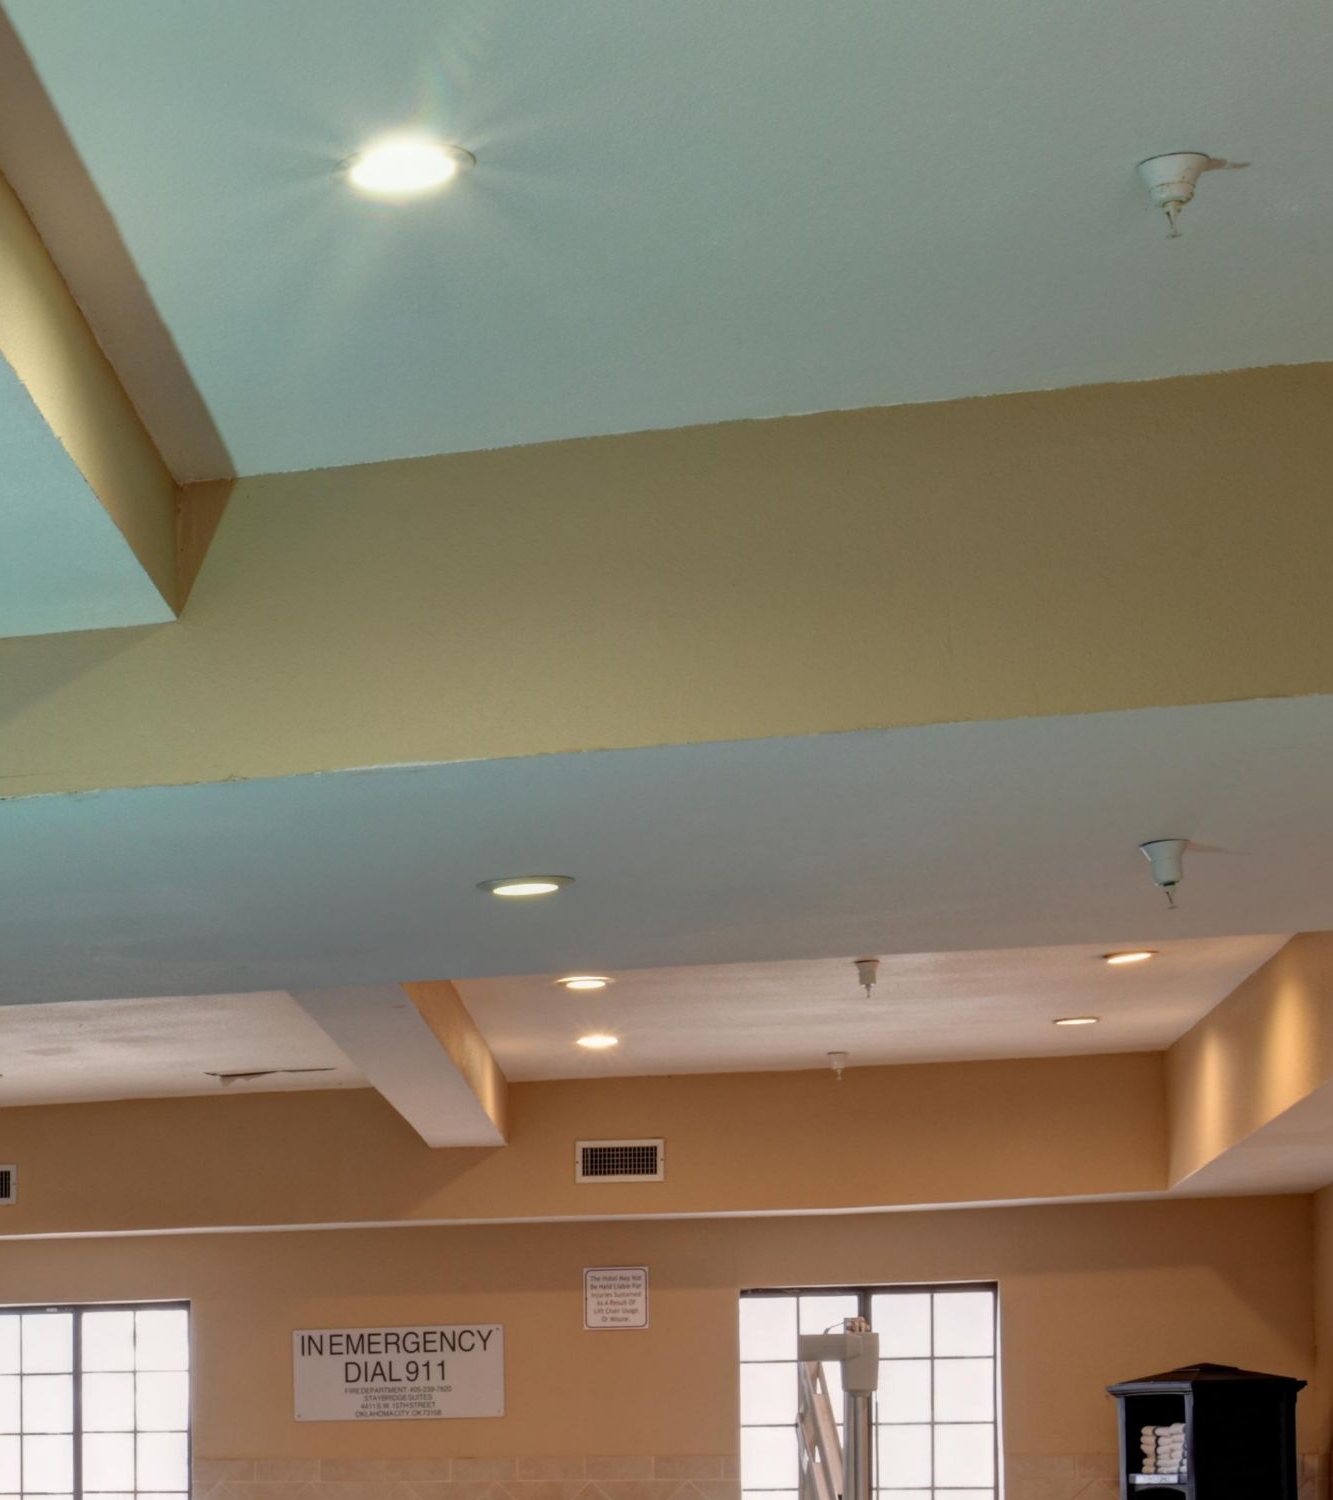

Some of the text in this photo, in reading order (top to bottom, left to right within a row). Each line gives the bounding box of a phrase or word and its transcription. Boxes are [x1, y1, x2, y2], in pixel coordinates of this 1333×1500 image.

[301, 1329, 493, 1356] IN EMERGENCY
[344, 1359, 446, 1383] DIAL 911
[361, 1386, 407, 1394] DEPARTMENT
[364, 1394, 406, 1402] STAYBRIDGE
